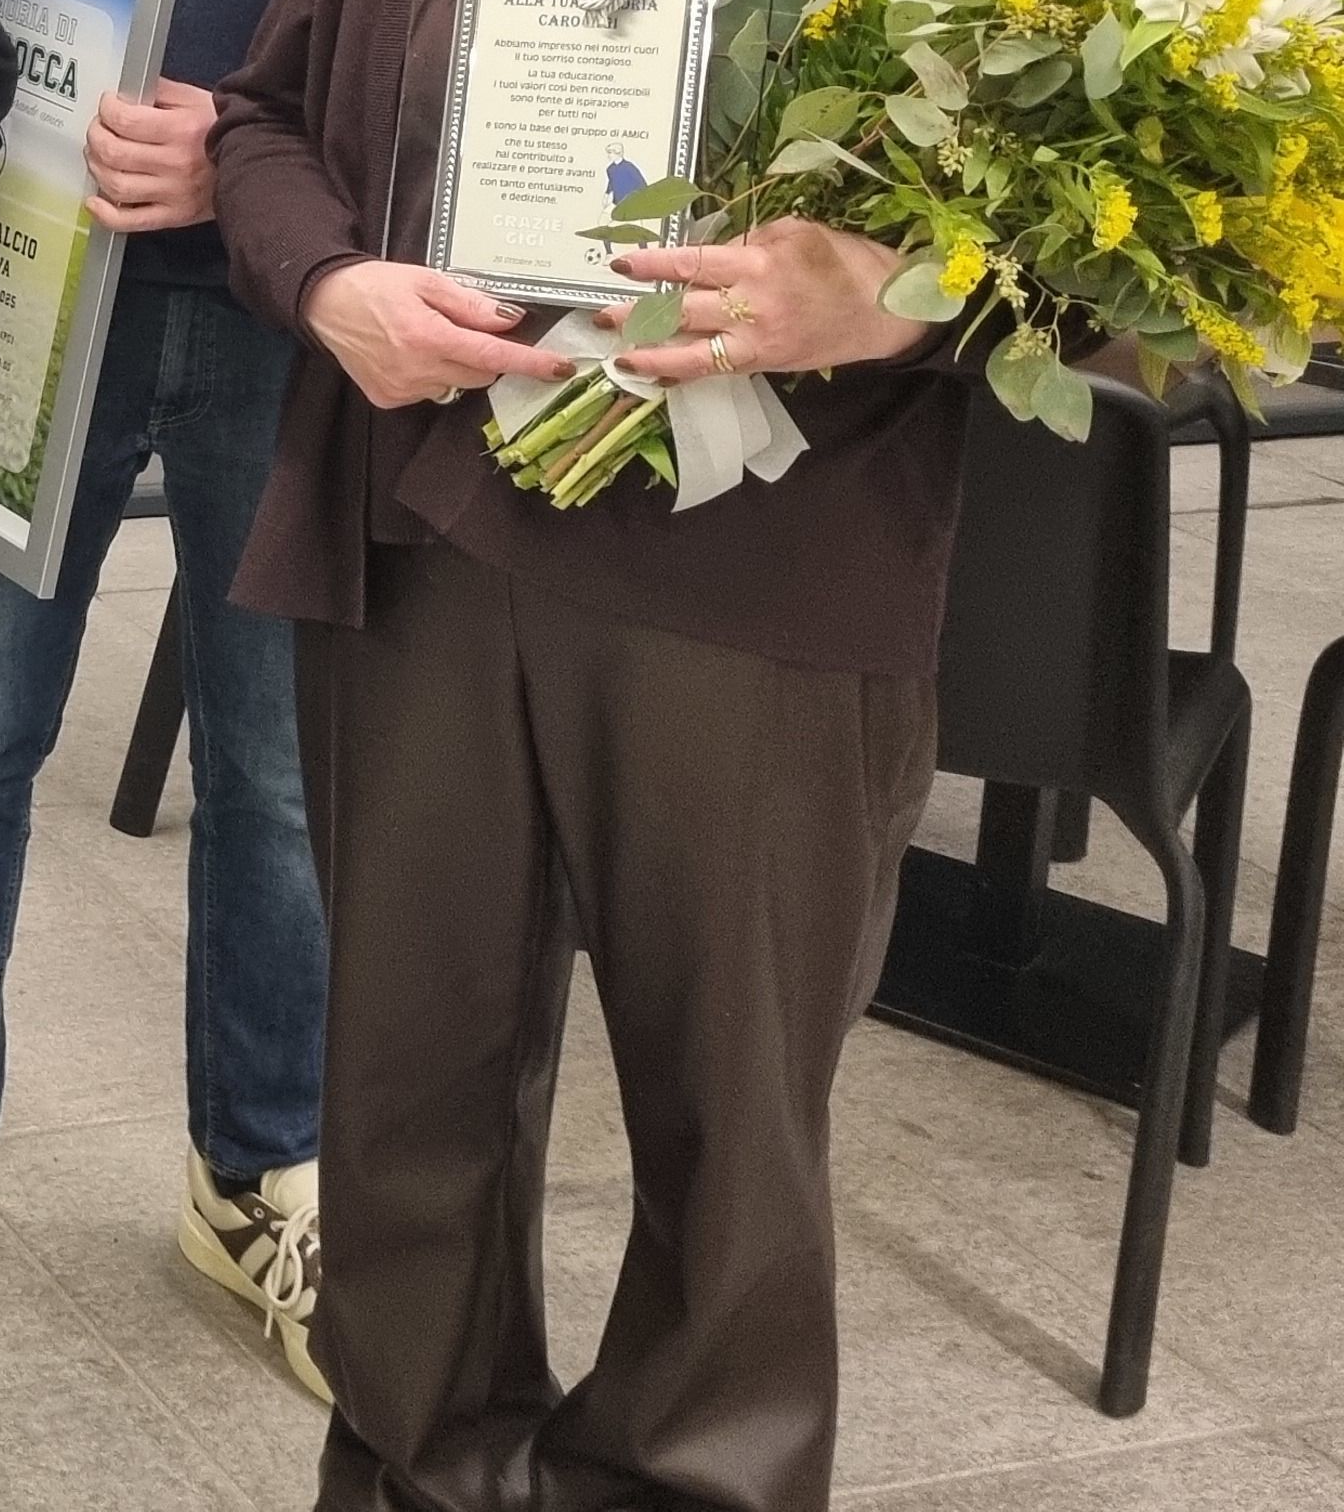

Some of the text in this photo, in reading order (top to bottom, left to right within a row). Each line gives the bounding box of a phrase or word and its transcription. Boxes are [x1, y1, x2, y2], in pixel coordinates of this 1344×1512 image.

[538, 15, 581, 27] CARO
[55, 13, 78, 46] DI
[494, 39, 659, 54] Abbiamo impresso nei nostri cuori
[523, 54, 539, 62] tuo
[542, 54, 574, 64] sorriso
[577, 57, 632, 67] contagioso
[12, 35, 79, 102] OCCA
[540, 70, 556, 78] tua
[499, 81, 518, 89] tuoi
[520, 82, 546, 92] valori
[569, 84, 588, 93] ben
[591, 85, 651, 97] riconoscibili
[14, 99, 38, 117] rande
[510, 94, 629, 109] sono fonte di ispirazione
[538, 108, 597, 120] per tutti noi
[494, 122, 517, 131] sono
[519, 123, 527, 131] la
[530, 124, 552, 132] base
[554, 125, 569, 133] del
[571, 127, 607, 137] gruppo
[610, 128, 619, 137] di
[621, 130, 649, 139] AMICI
[504, 138, 568, 150] che tu stesso
[495, 150, 509, 159] hai
[512, 152, 566, 163] contribuito
[472, 161, 595, 177] realizzare e portare avanti
[480, 178, 584, 193] con tanto entusiasmo
[493, 214, 561, 232] GRAZIE
[505, 233, 544, 246] GIGI
